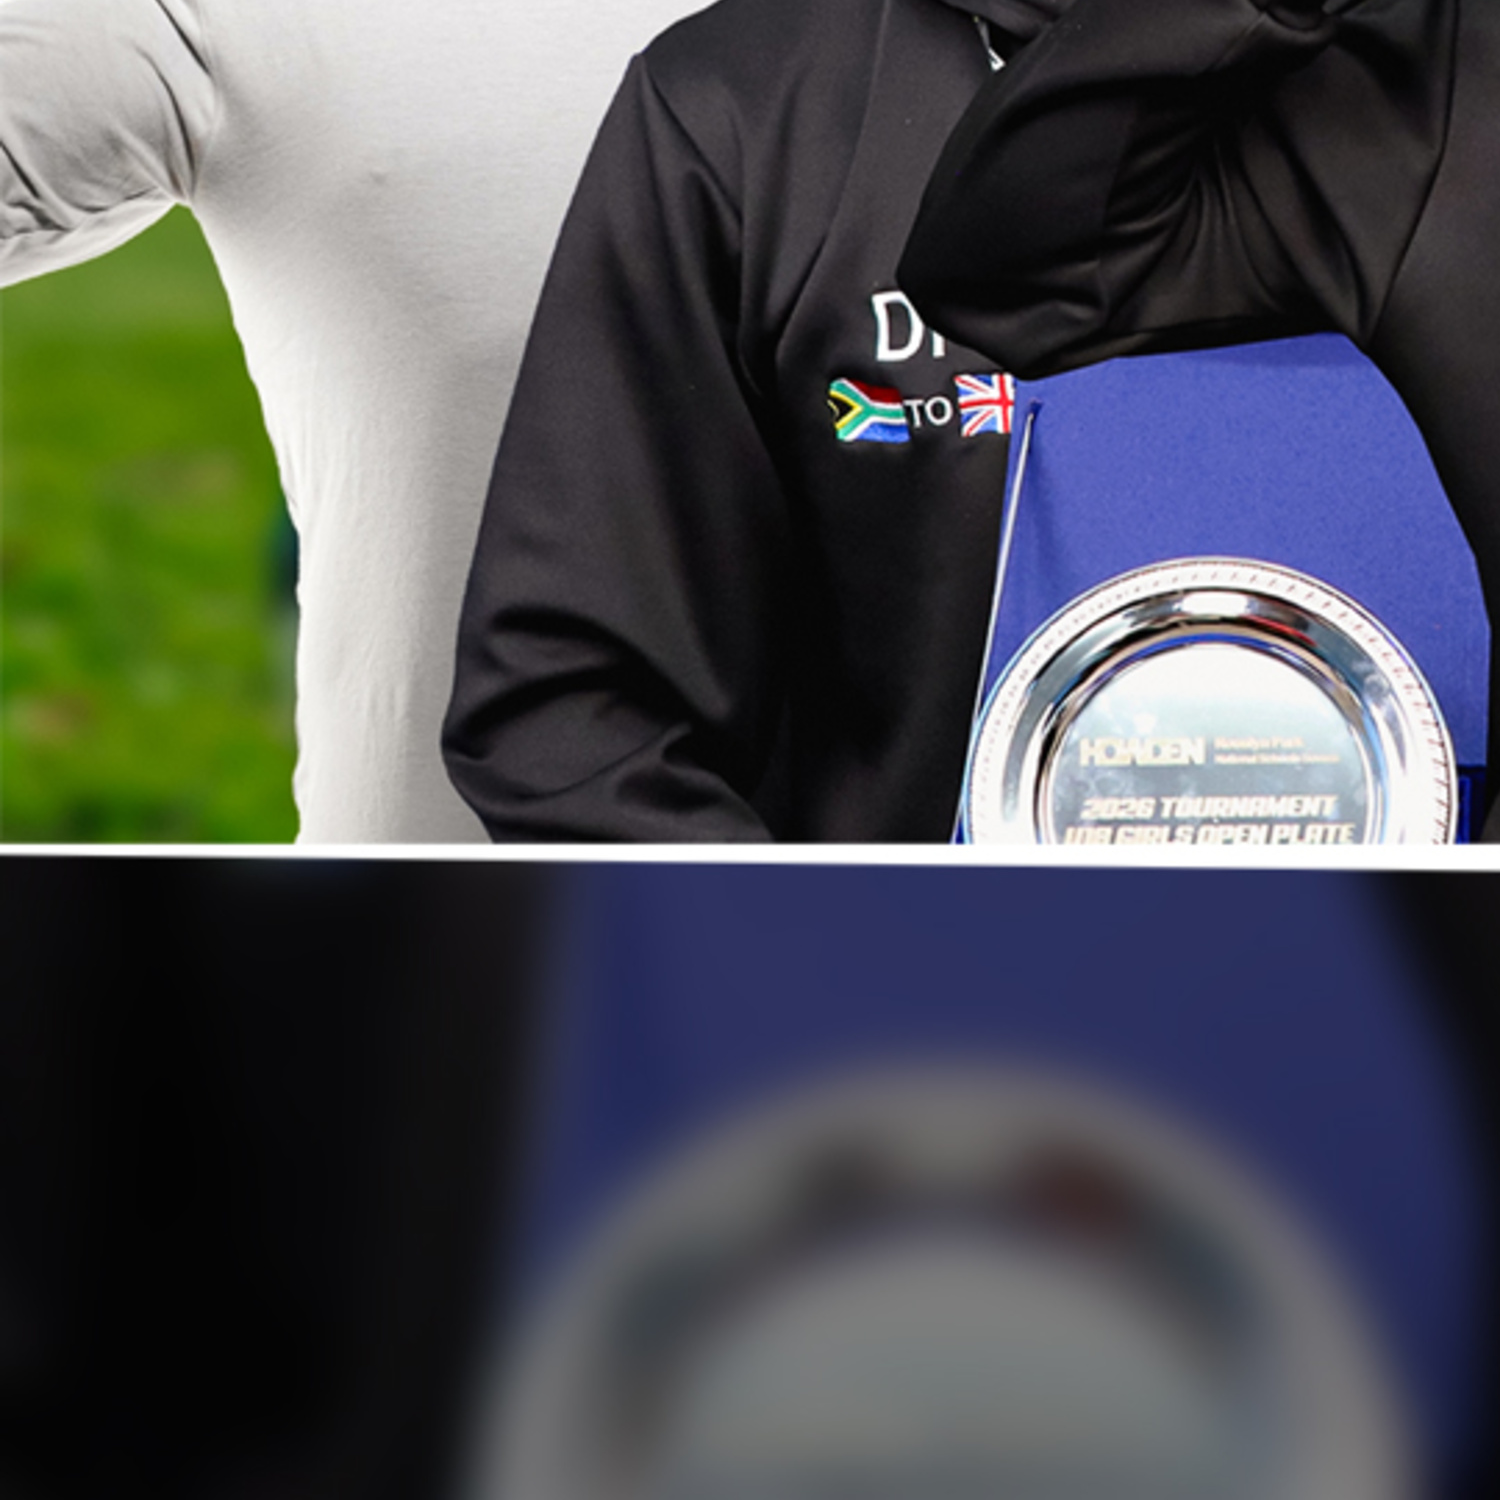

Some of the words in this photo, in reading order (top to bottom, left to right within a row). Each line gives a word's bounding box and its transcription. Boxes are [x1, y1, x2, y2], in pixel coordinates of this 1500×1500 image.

[903, 396, 953, 428] TO
[1079, 737, 1206, 767] HOWDEN
[1160, 794, 1338, 819] TOURNAMENT
[1196, 823, 1270, 845] OPEN
[1270, 822, 1355, 845] PLATE
